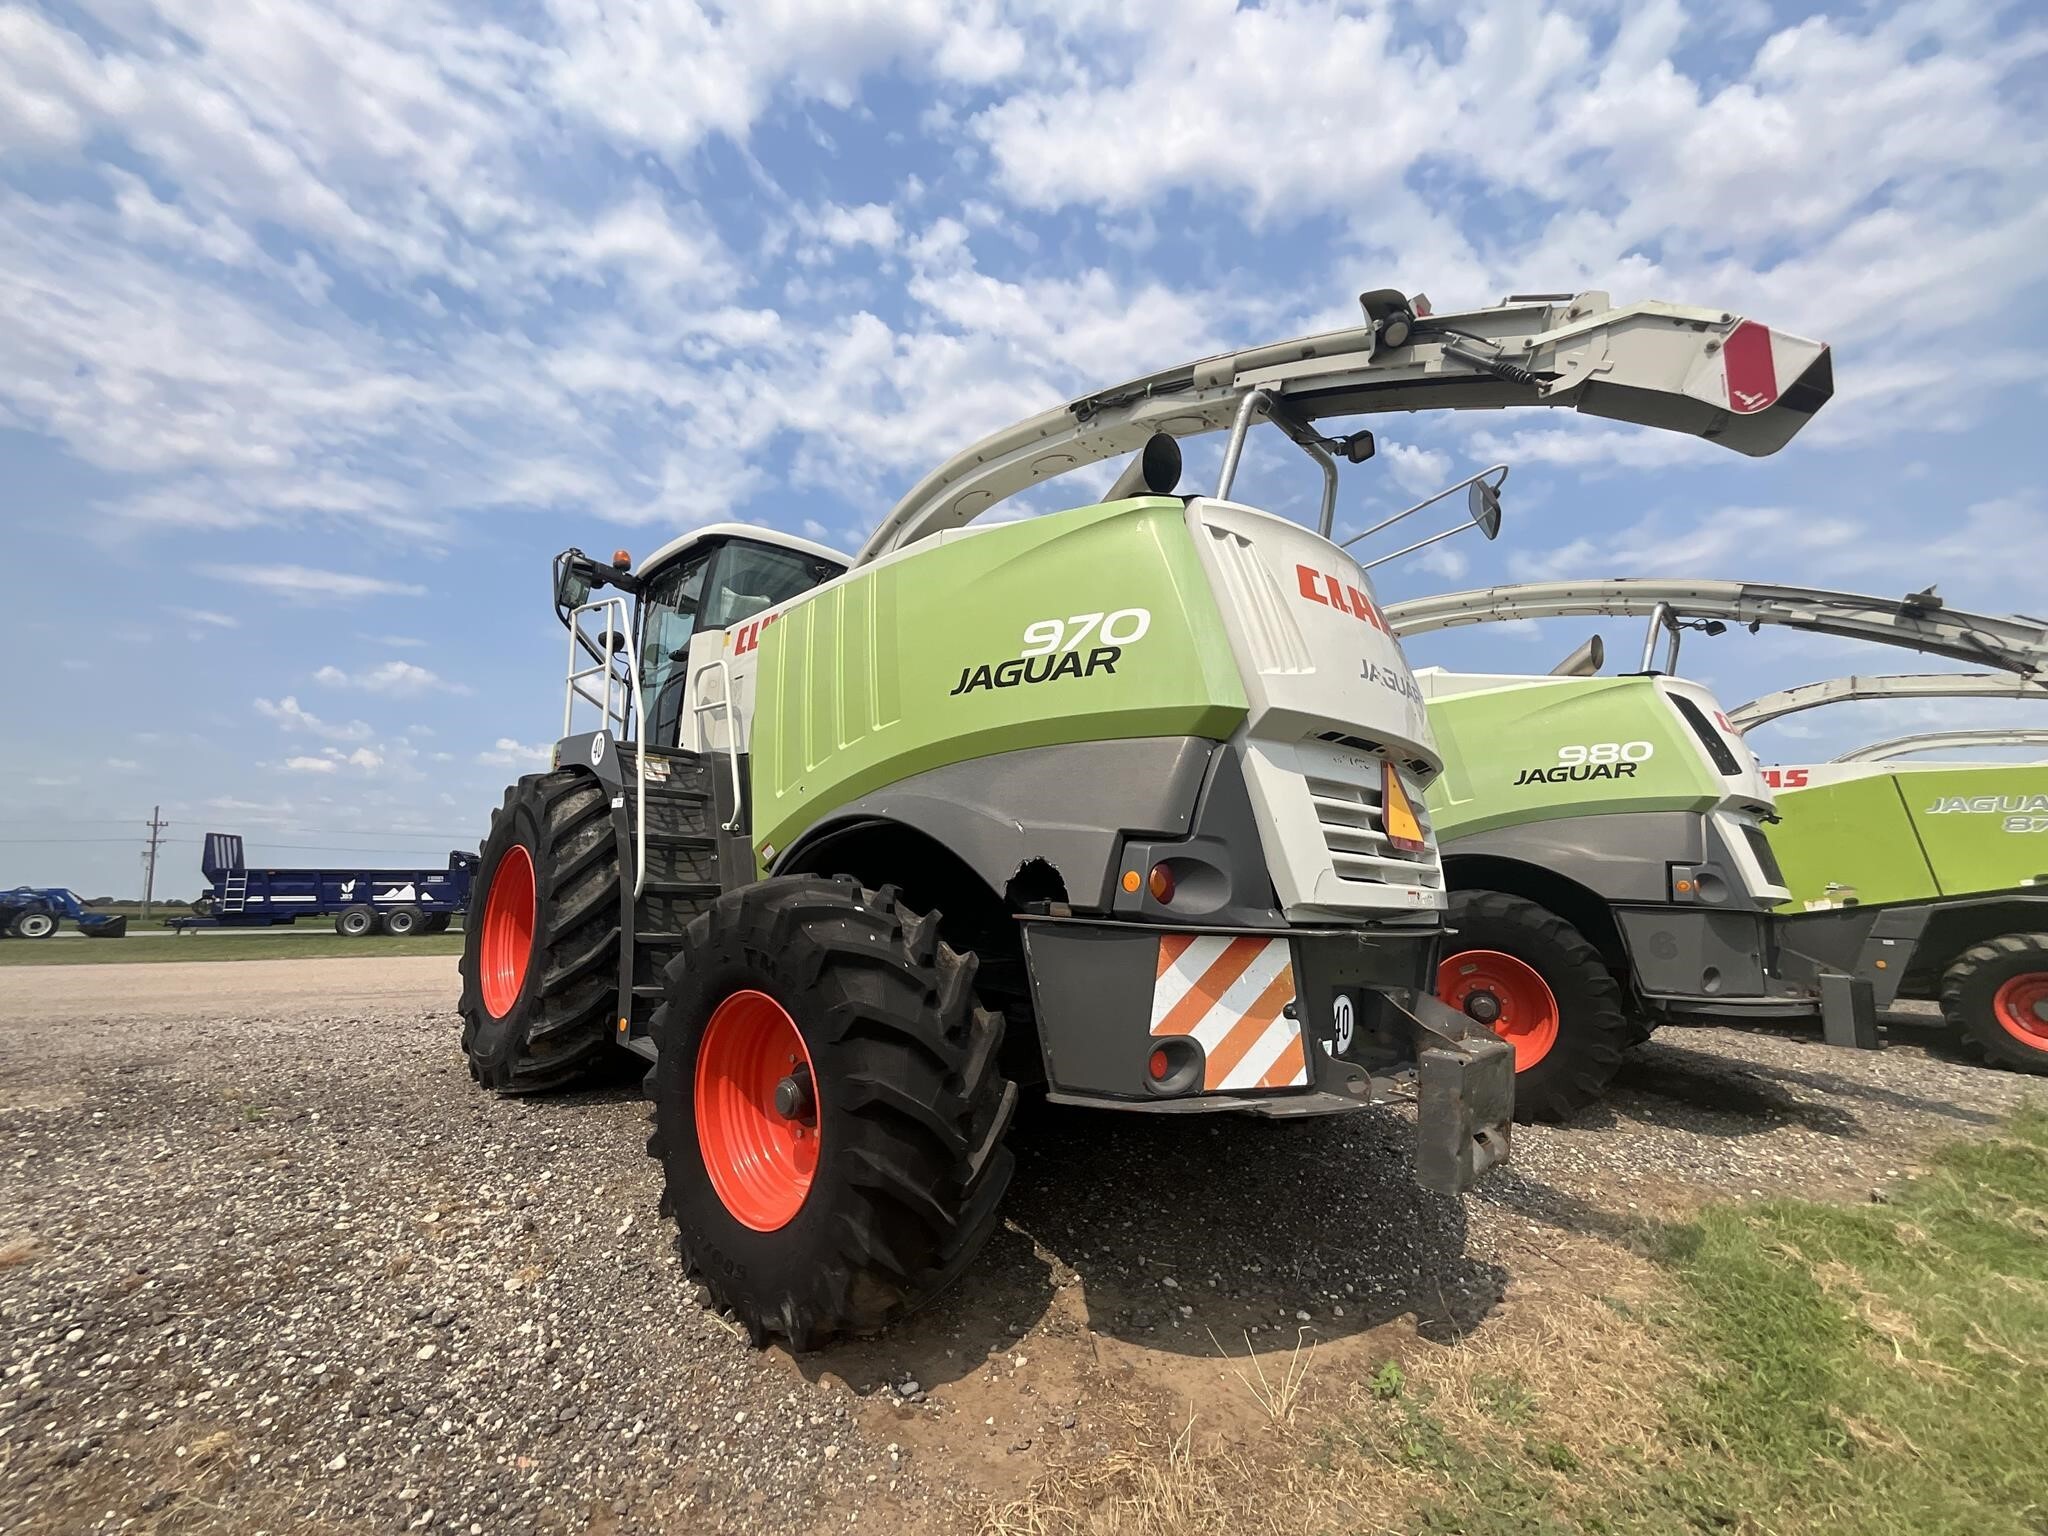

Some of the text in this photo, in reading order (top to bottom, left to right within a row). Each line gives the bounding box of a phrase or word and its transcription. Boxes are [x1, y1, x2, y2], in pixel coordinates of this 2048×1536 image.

[1020, 607, 1151, 658] 970
[949, 646, 1122, 696] JAGUAR
[1558, 741, 1654, 768] 980
[1513, 762, 1638, 786] JAGUAR
